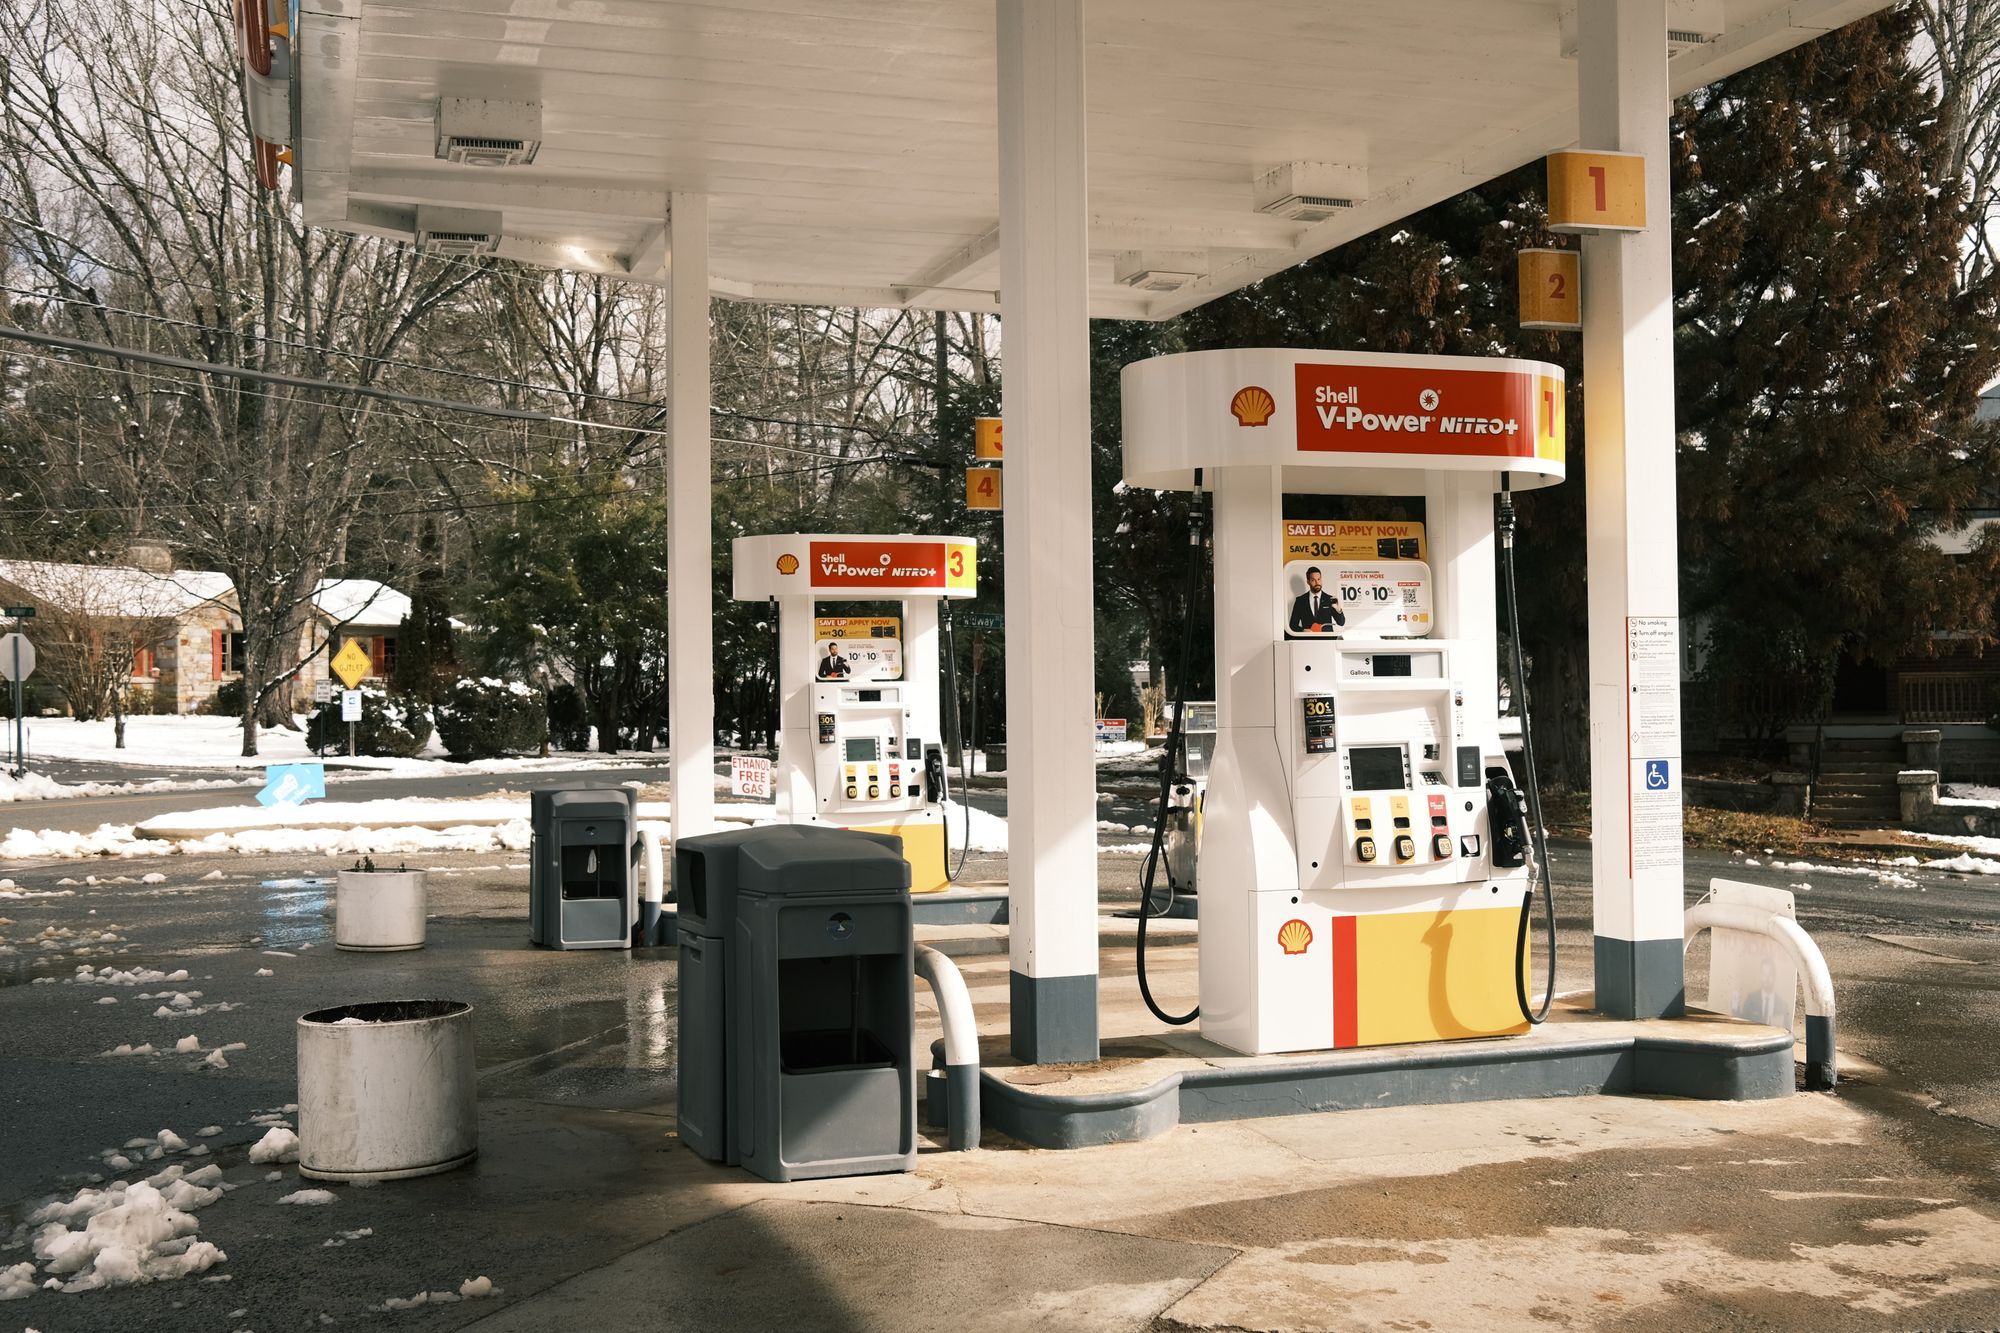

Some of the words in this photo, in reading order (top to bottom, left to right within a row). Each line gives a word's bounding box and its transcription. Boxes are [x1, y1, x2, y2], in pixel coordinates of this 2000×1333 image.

[1589, 167, 1606, 211] 1
[1549, 274, 1566, 299] 2
[1315, 385, 1358, 404] Shell
[1316, 405, 1431, 433] V-Power
[1544, 390, 1555, 438] 1
[977, 476, 994, 497] 4
[1288, 524, 1315, 536] SAVE
[1339, 525, 1373, 536] APPLY
[1289, 545, 1309, 553] SAVE
[821, 553, 845, 564] Shell
[949, 550, 964, 578] 3
[821, 564, 885, 577] V-Power
[1647, 619, 1667, 627] smoking
[1365, 657, 1370, 665] $
[339, 664, 364, 672] OUTLET
[732, 757, 770, 771] ETHANOL
[739, 771, 766, 783] FREE
[742, 783, 764, 795] GAS
[1362, 846, 1374, 854] 87
[1402, 844, 1413, 852] 89
